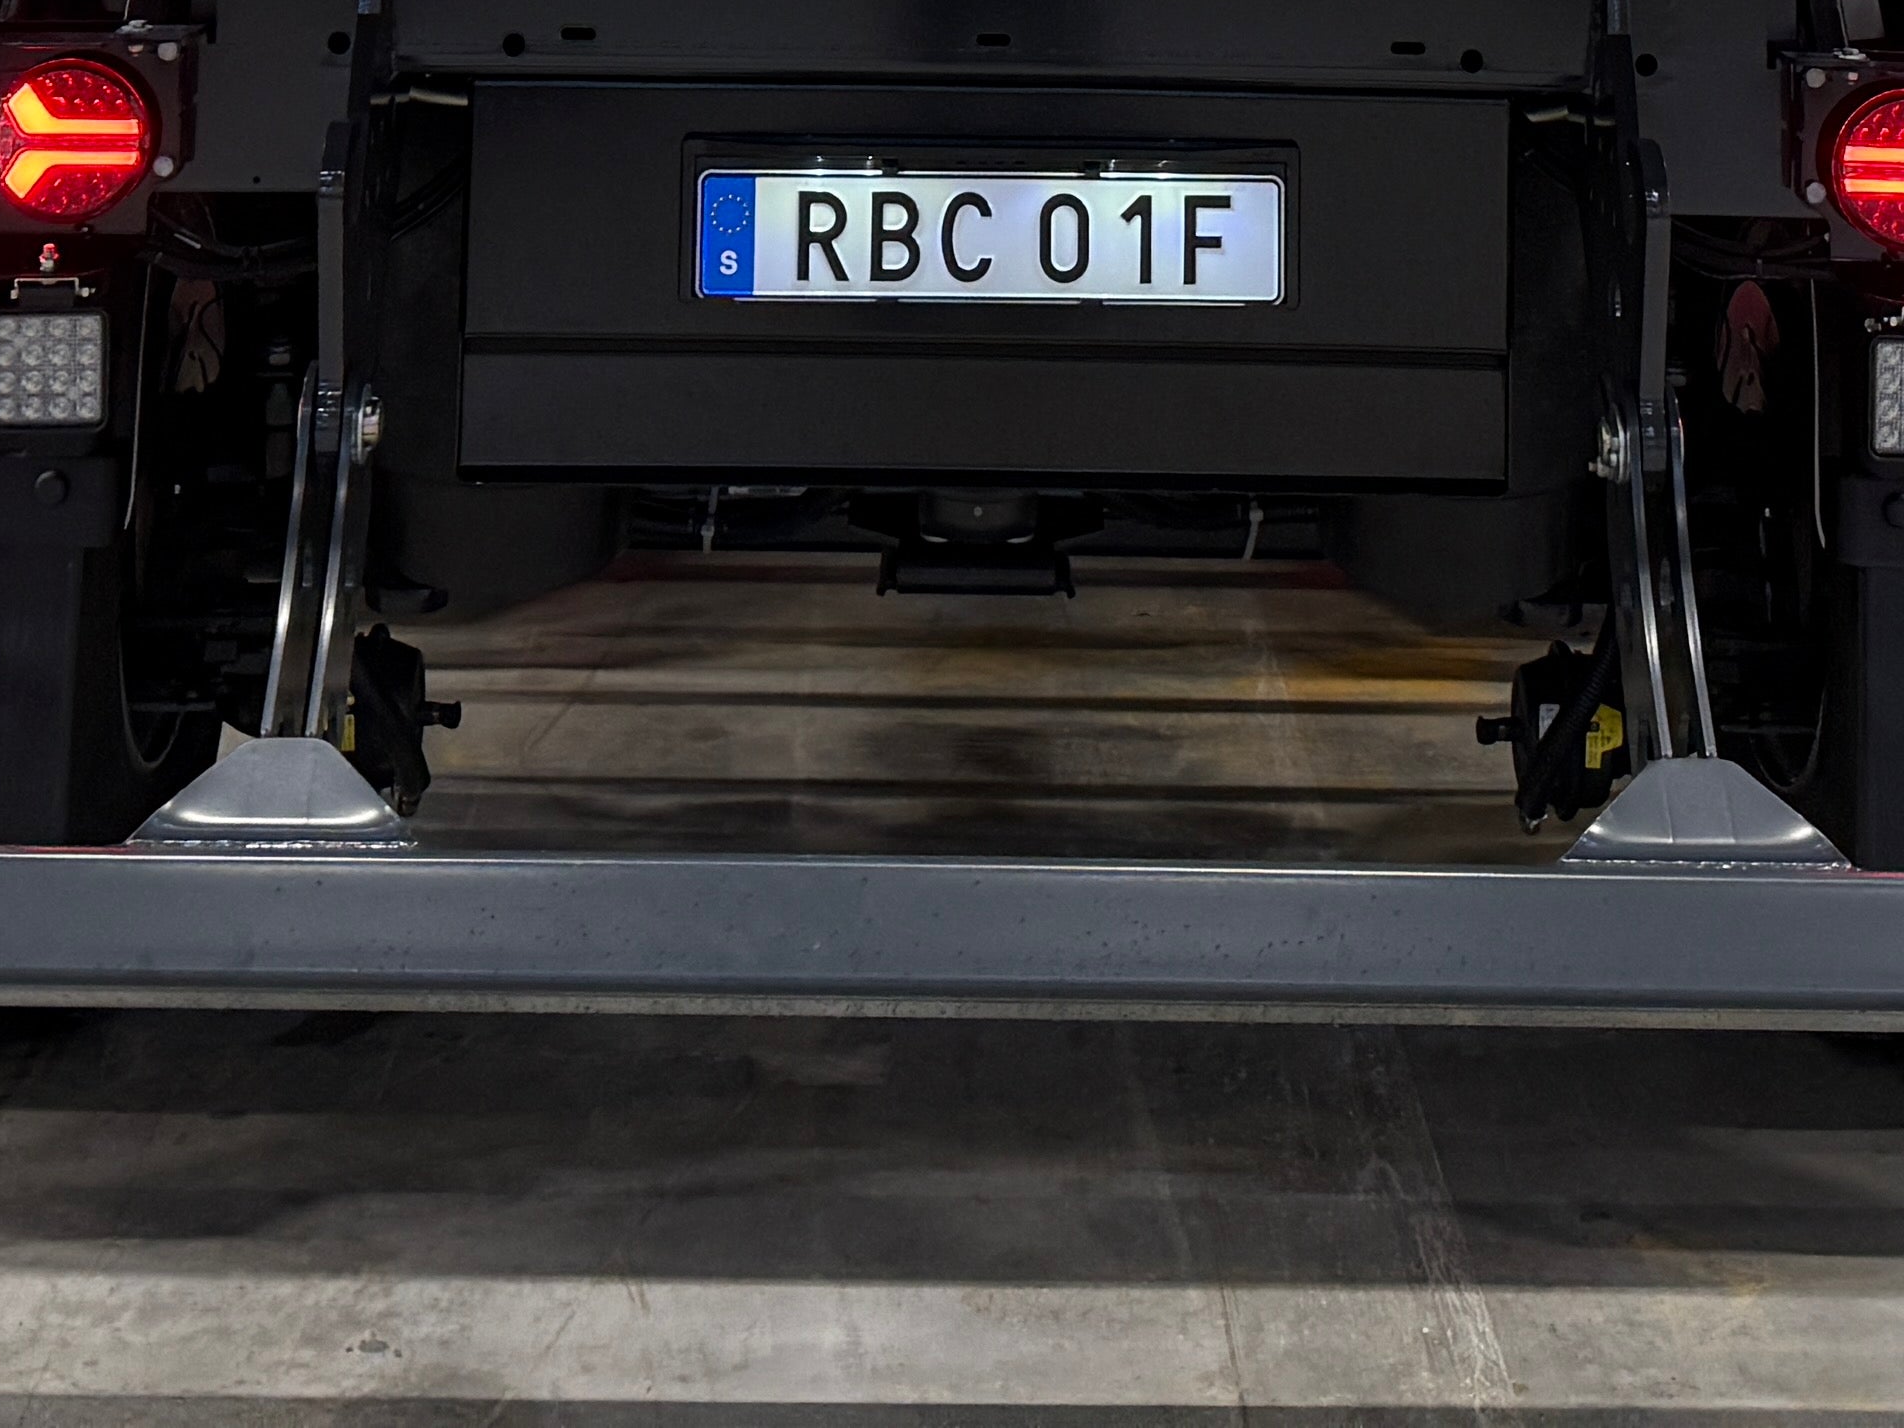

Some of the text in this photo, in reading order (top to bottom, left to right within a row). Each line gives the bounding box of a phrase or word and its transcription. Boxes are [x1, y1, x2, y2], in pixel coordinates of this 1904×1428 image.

[718, 249, 738, 275] S
[795, 190, 1233, 285] RBC 01F
